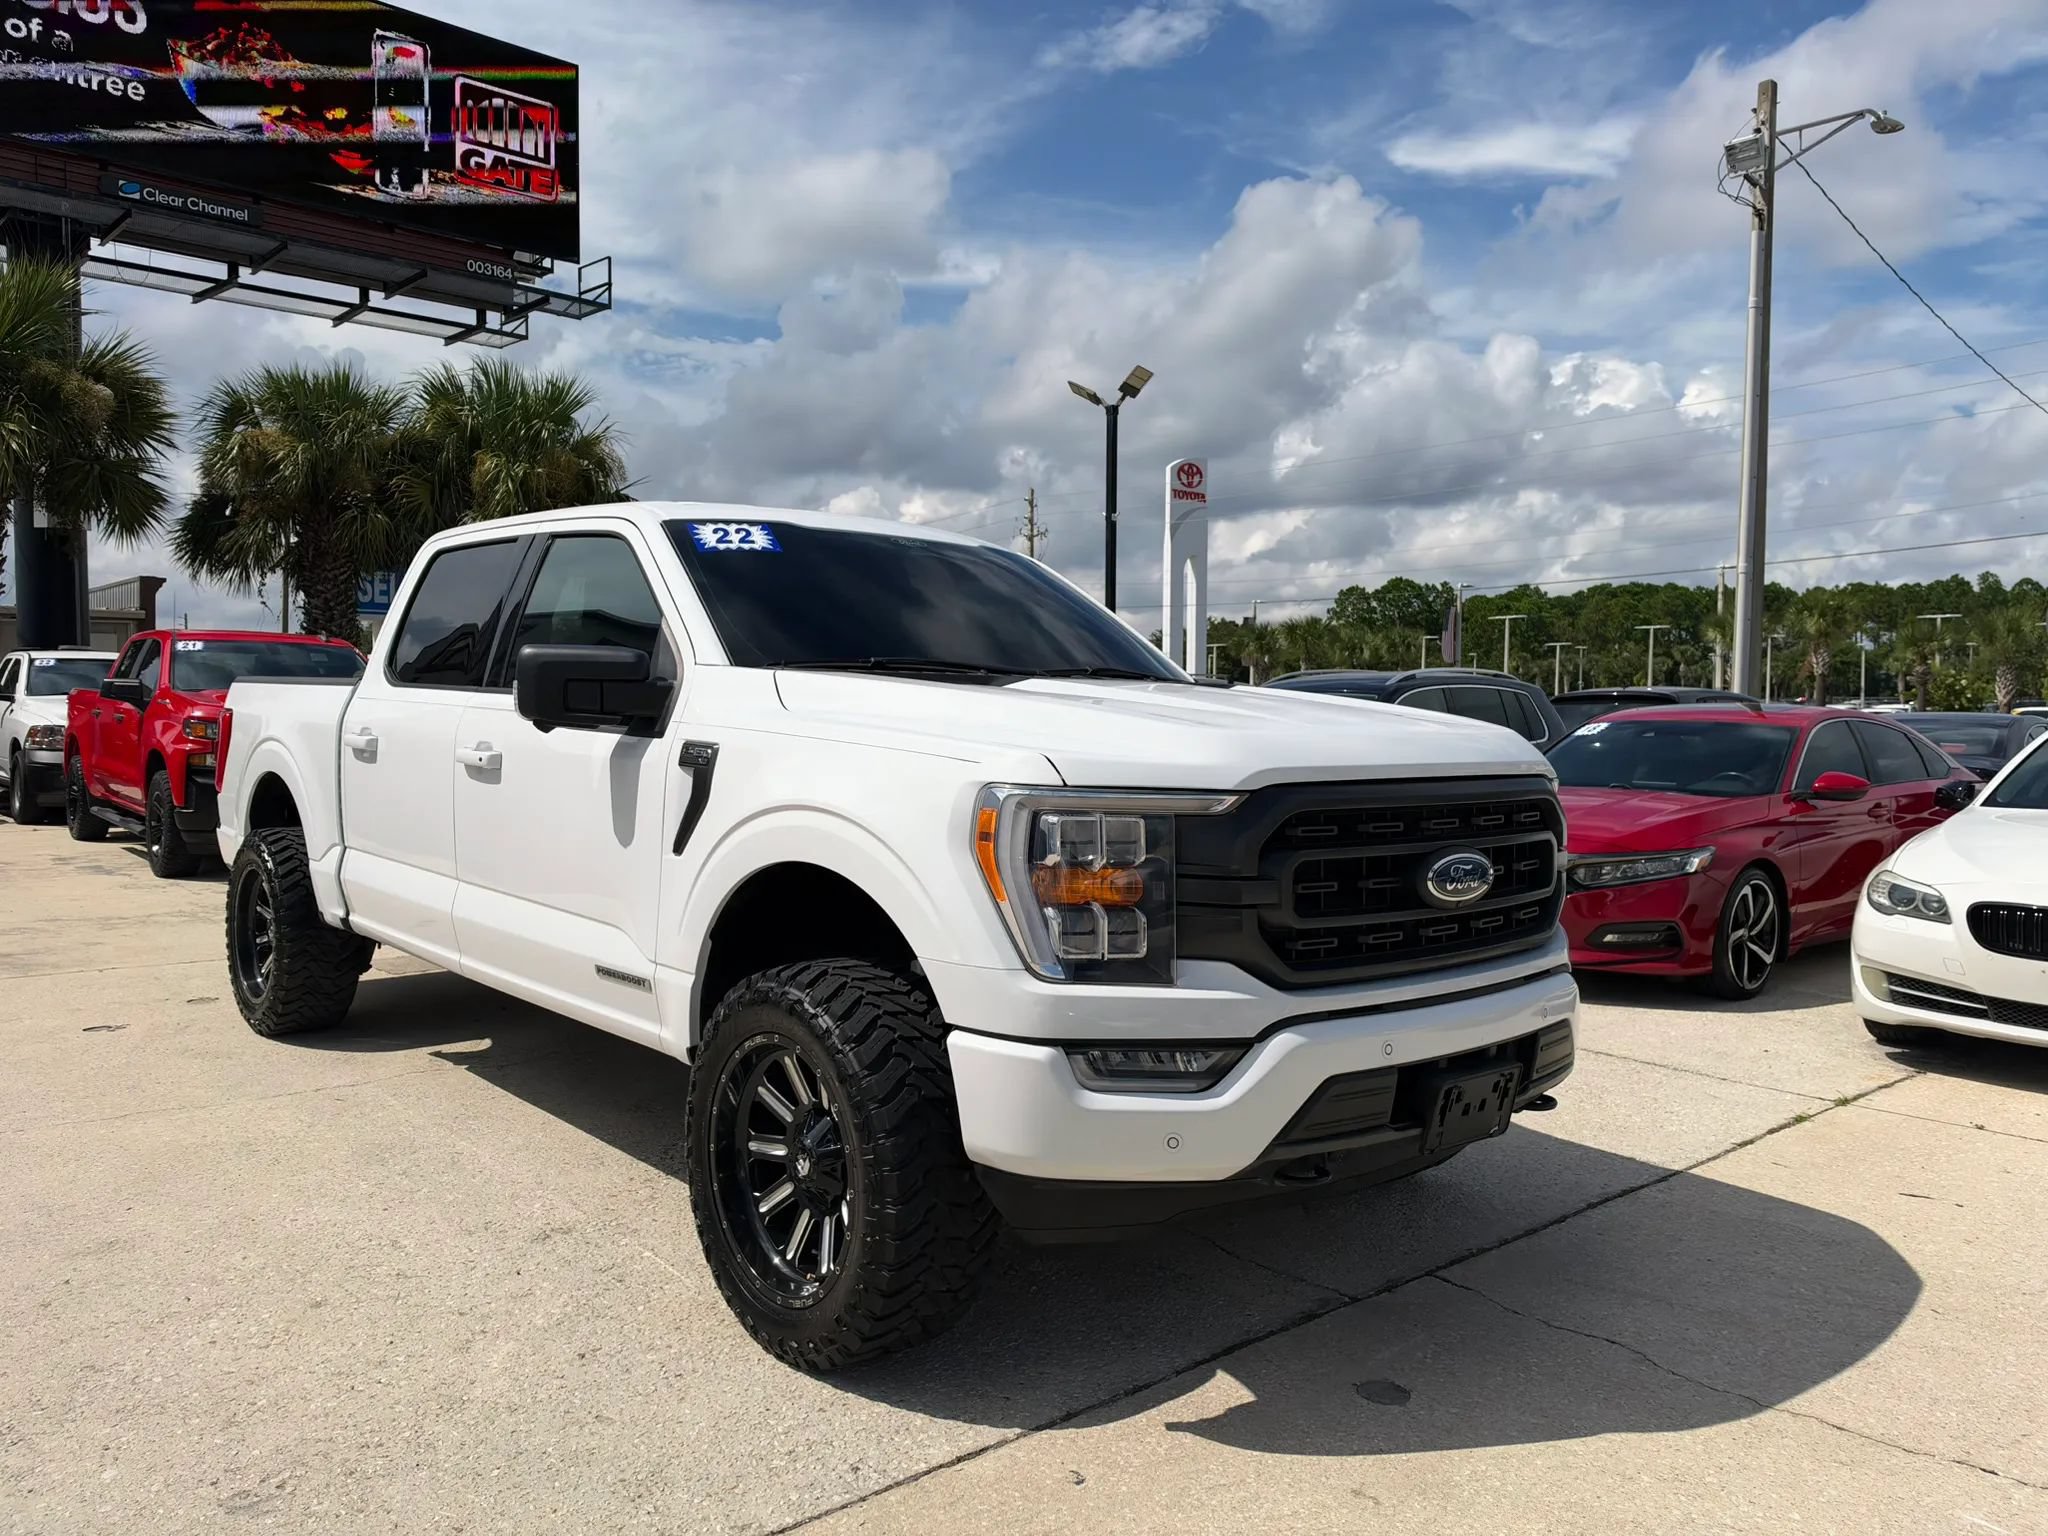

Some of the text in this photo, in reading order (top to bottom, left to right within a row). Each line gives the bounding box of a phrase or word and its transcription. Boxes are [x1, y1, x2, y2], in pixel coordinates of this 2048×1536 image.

[4, 17, 43, 43] of
[143, 187, 249, 221] Clear Channel
[466, 259, 512, 280] 003164
[712, 527, 757, 545] 22
[181, 642, 198, 650] 21
[1445, 864, 1482, 891] Ford
[743, 1035, 768, 1050] FUEL
[788, 1297, 814, 1308] FUEL
